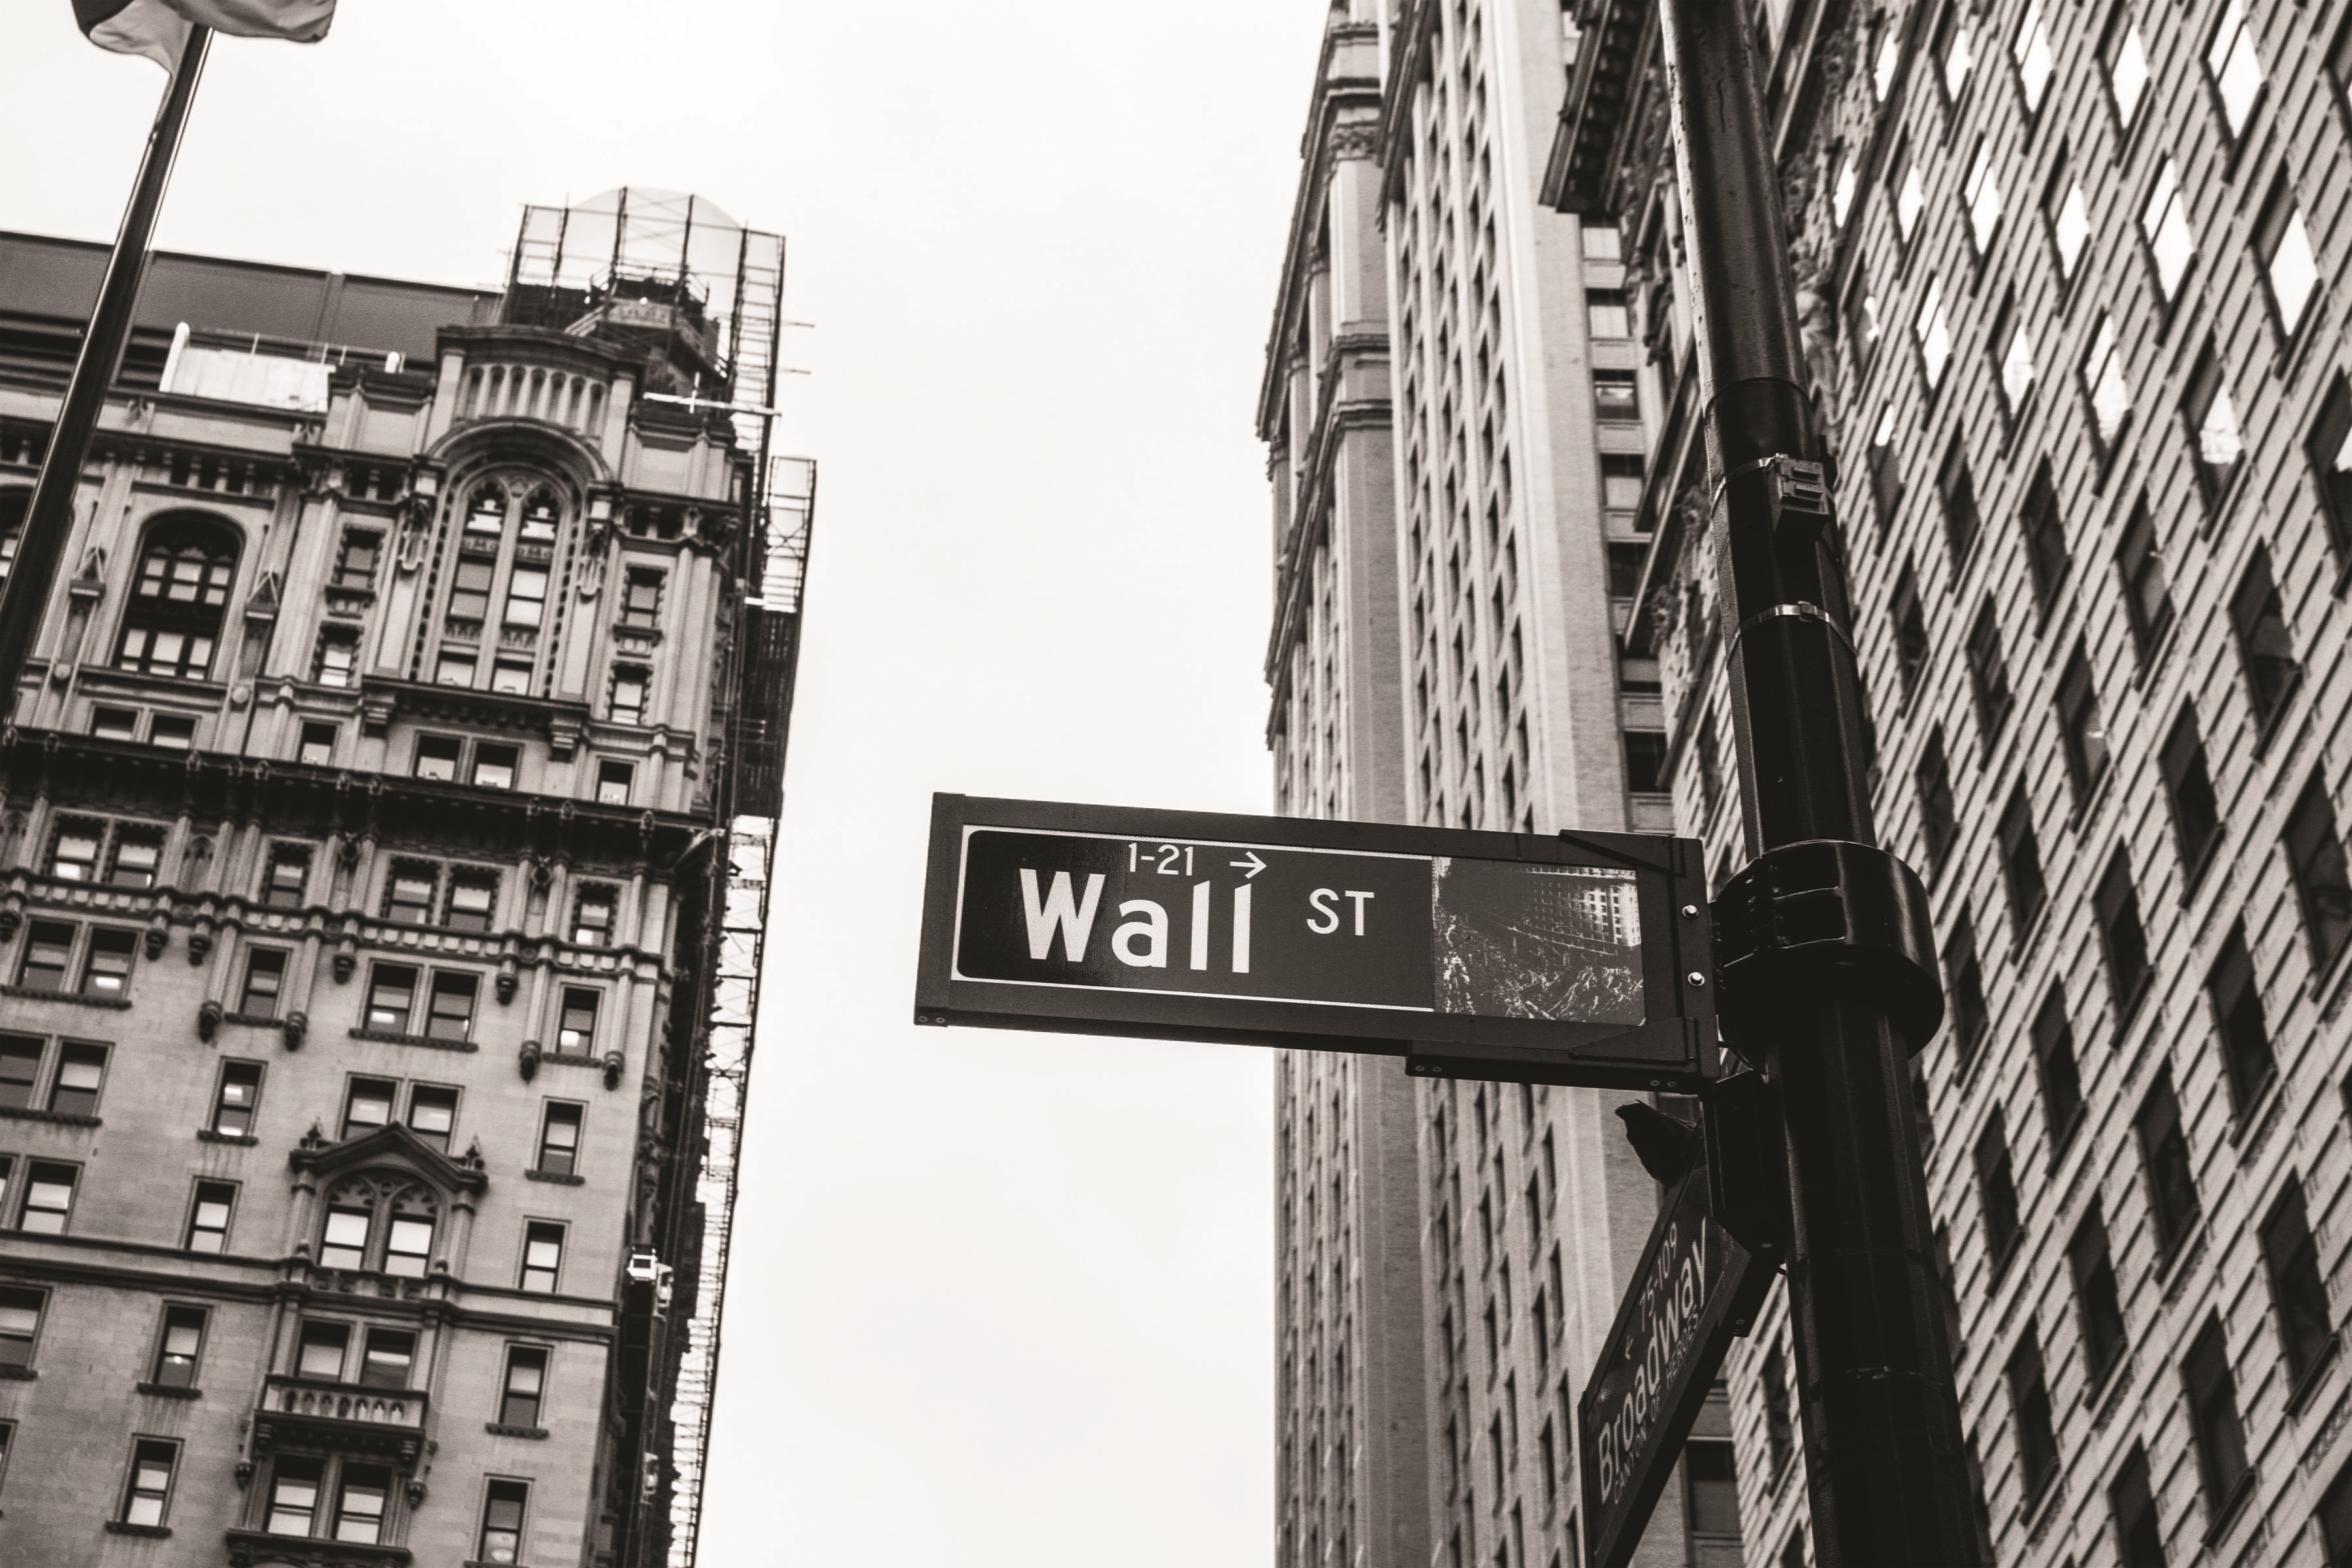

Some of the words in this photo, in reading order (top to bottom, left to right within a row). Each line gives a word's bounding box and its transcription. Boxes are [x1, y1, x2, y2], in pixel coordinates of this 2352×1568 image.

[1128, 842, 1194, 877] 1-21
[1019, 868, 1252, 974] Wall
[1305, 887, 1375, 937] ST
[1639, 1221, 1678, 1333] 75-109
[1599, 1217, 1706, 1504] Broadway
[1614, 1419, 1646, 1504] CANYON
[1651, 1385, 1661, 1422] OF
[1666, 1304, 1699, 1390] HEROES
